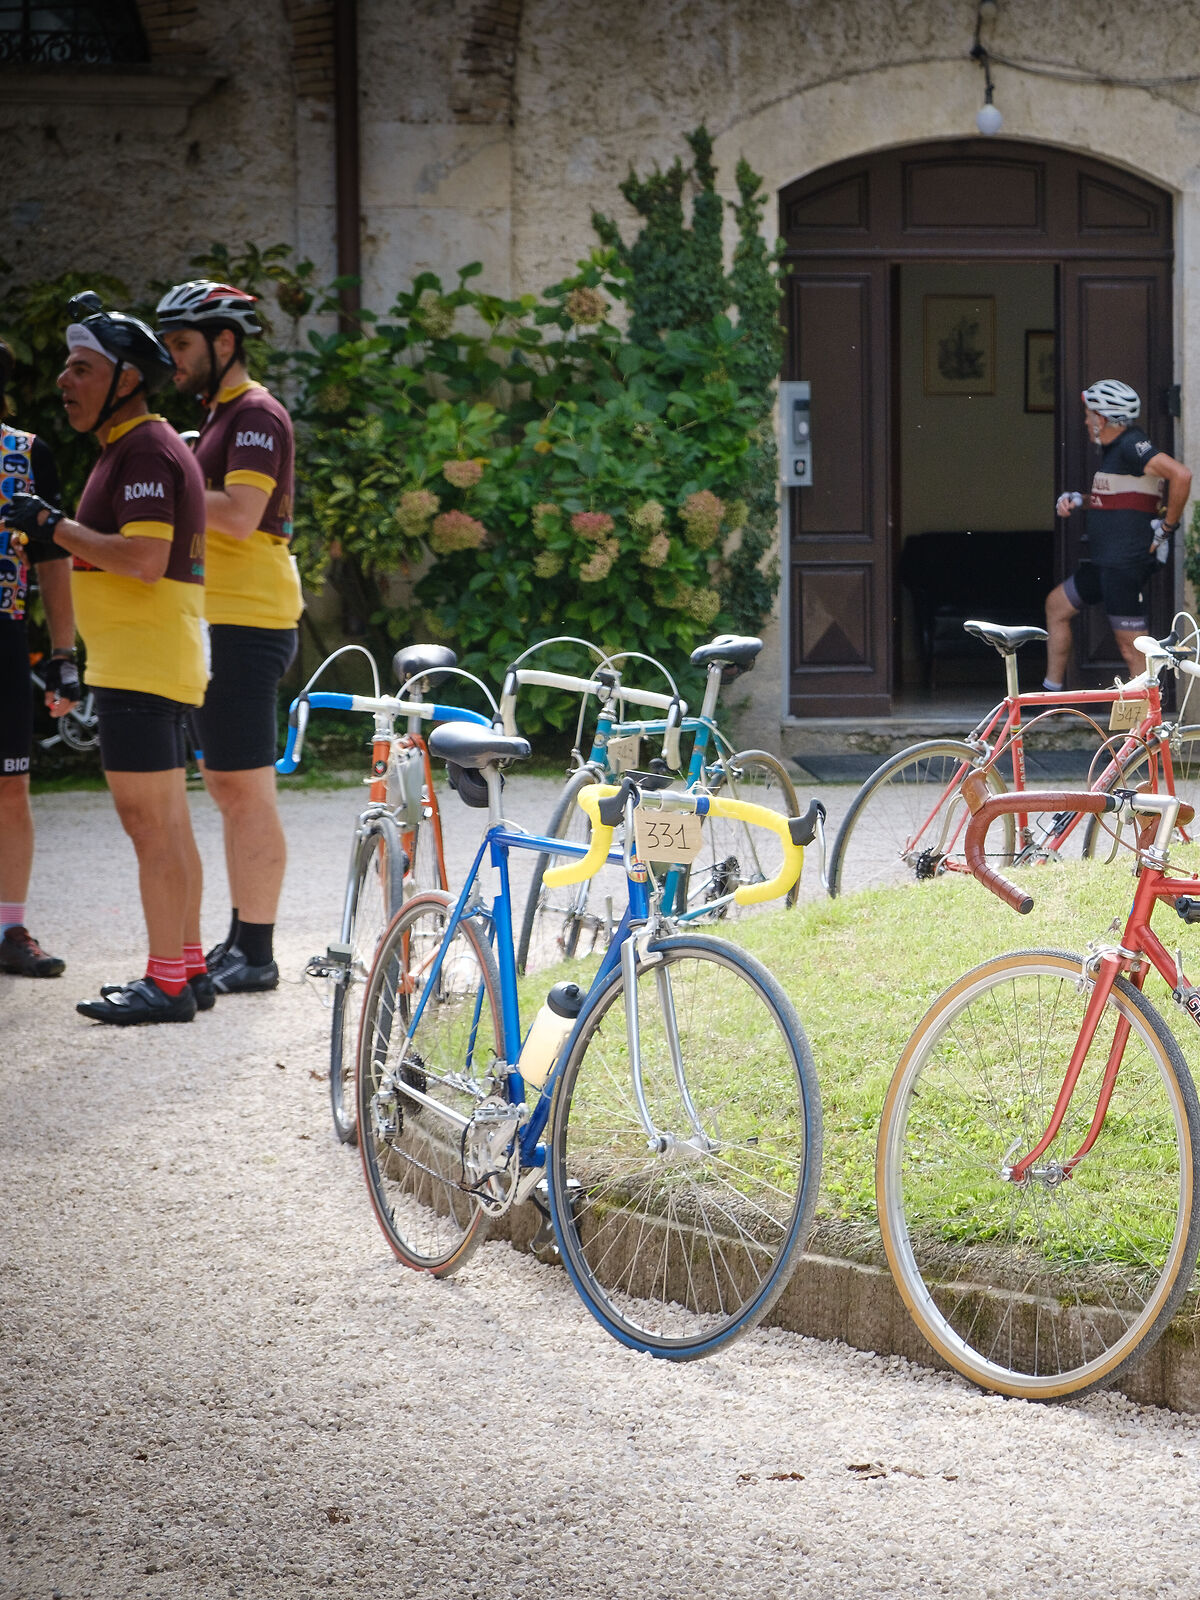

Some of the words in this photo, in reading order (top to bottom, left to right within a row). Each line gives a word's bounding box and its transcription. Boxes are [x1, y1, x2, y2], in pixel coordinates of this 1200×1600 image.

[236, 431, 274, 452] ROMA
[125, 482, 164, 500] ROMA
[1117, 706, 1142, 723] 347
[645, 821, 691, 850] 331
